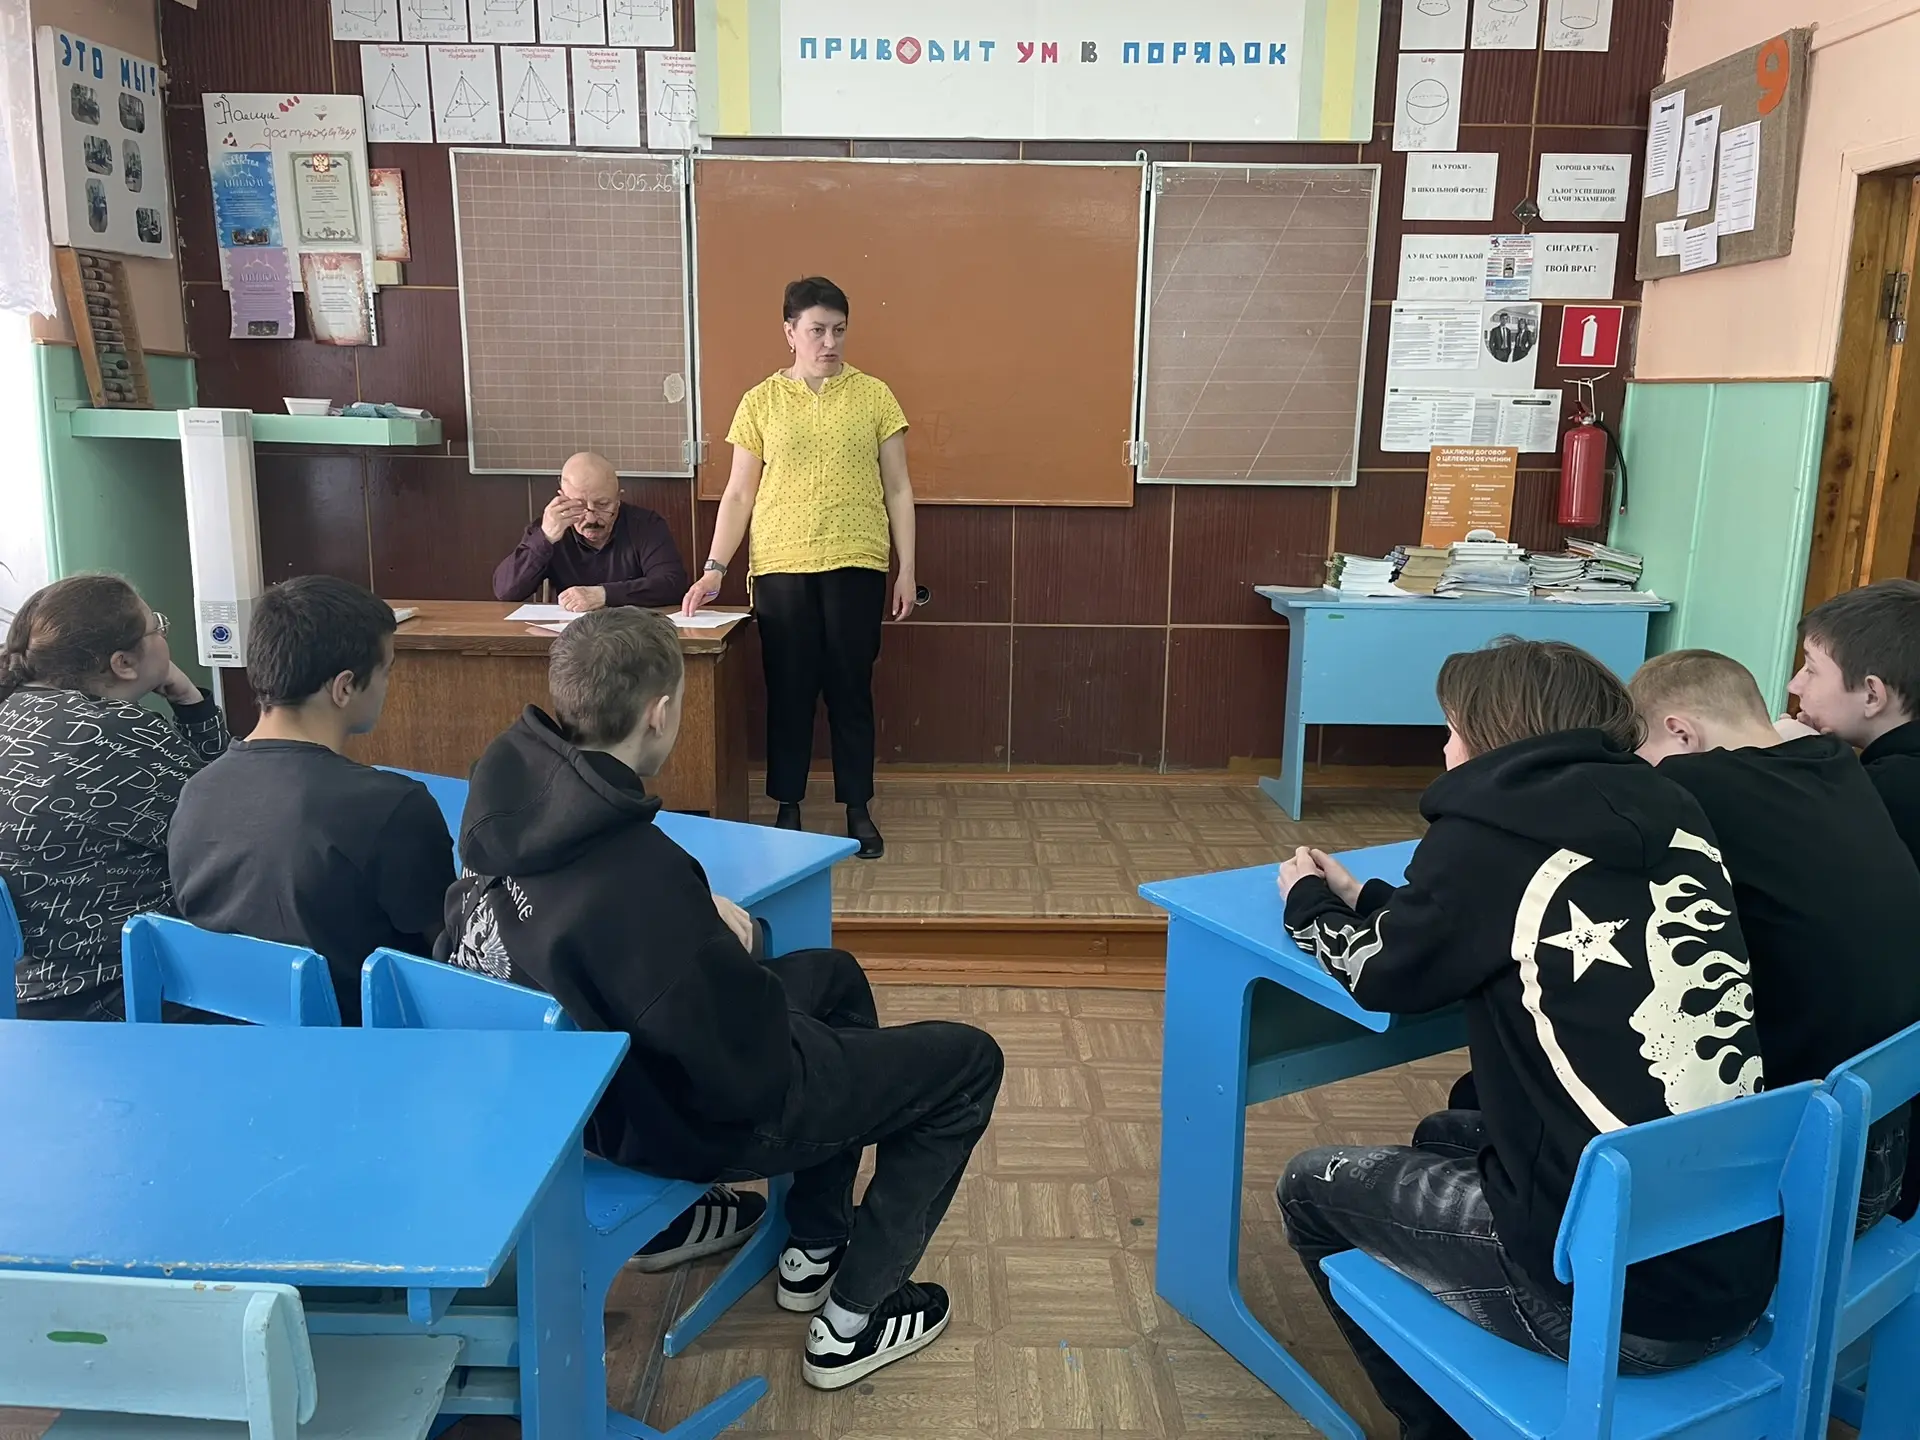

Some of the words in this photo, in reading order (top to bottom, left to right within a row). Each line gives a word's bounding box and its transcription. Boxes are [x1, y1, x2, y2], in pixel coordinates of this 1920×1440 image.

[60, 33, 104, 80] ЭТО
[120, 57, 156, 97] МЫ!
[800, 36, 996, 65] ПРИВОДИТ
[1016, 41, 1059, 64] УМ
[1081, 41, 1099, 64] В
[1123, 42, 1287, 67] ПОРЯДОК
[1756, 35, 1790, 117] 9
[1545, 244, 1593, 252] СИГАРЕТА
[1545, 263, 1569, 272] ТВОЙ
